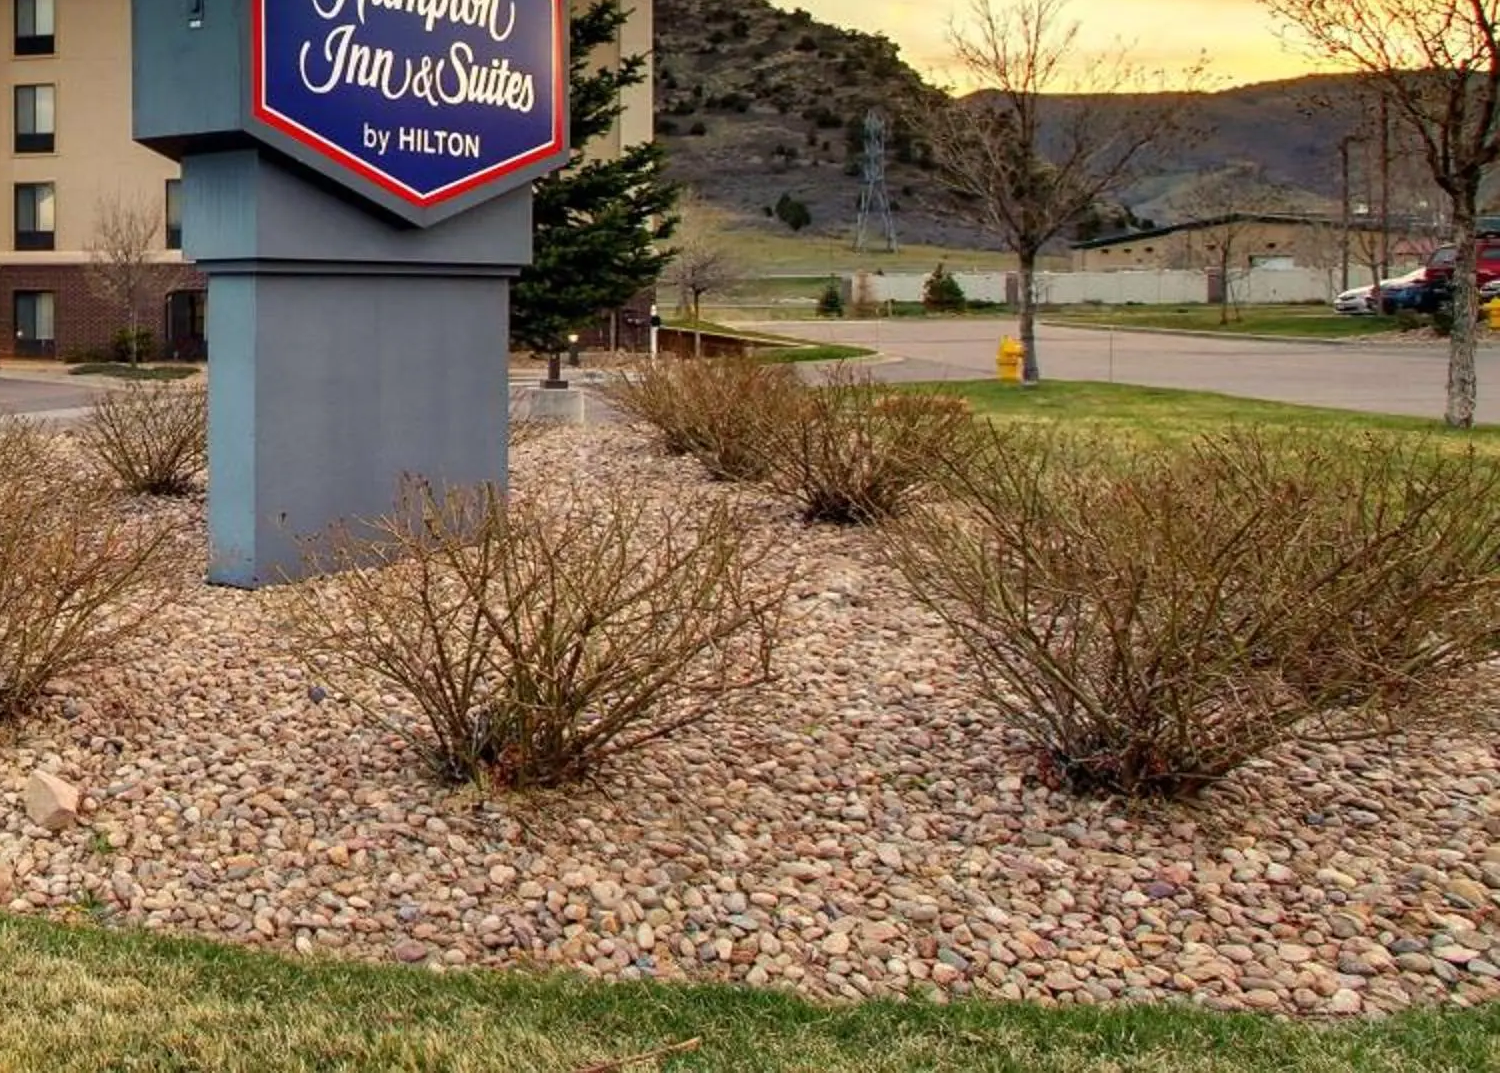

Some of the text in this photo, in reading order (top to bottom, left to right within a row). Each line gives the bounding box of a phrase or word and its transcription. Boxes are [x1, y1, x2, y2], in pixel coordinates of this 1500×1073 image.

[300, 24, 535, 114] Inn & Suites
[363, 122, 481, 159] by HILTON
